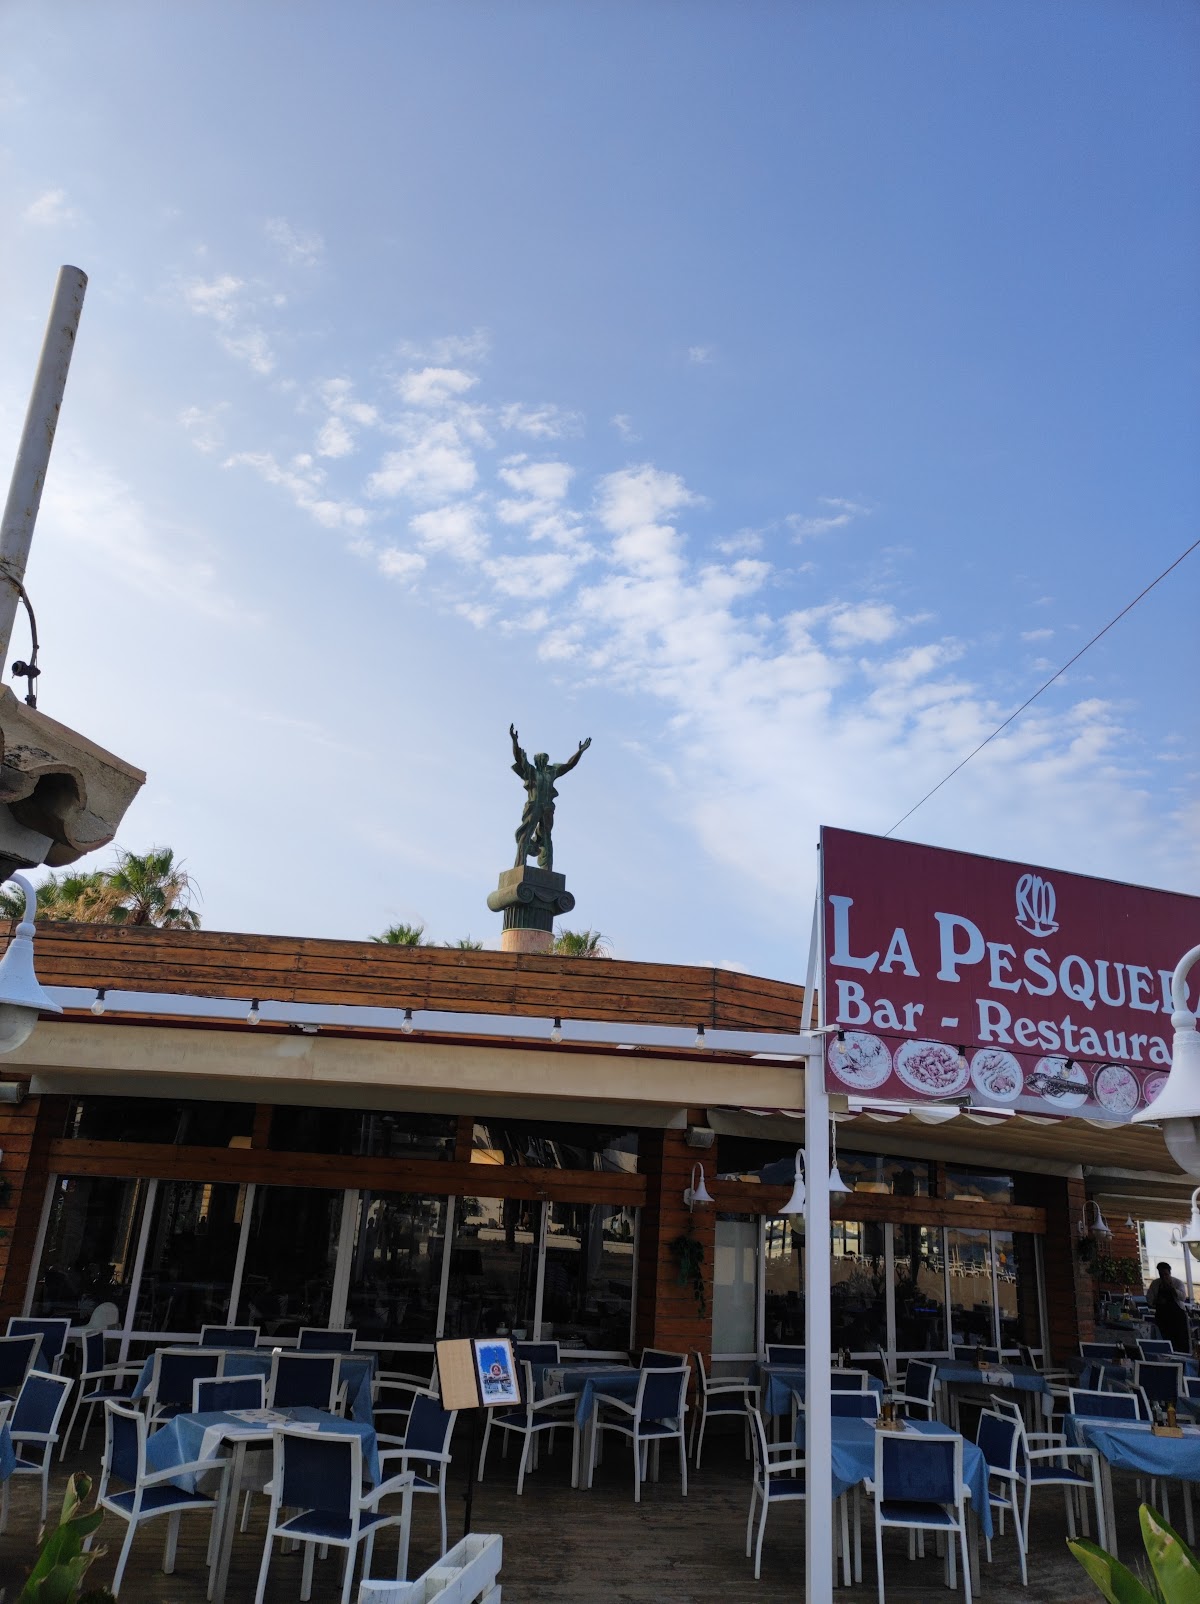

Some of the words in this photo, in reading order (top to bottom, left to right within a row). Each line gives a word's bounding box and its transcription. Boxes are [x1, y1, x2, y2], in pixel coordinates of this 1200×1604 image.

[829, 895, 920, 977] LA
[934, 912, 1200, 1018] PESQUER
[835, 979, 924, 1032] Bar
[976, 998, 1174, 1066] Restaura
